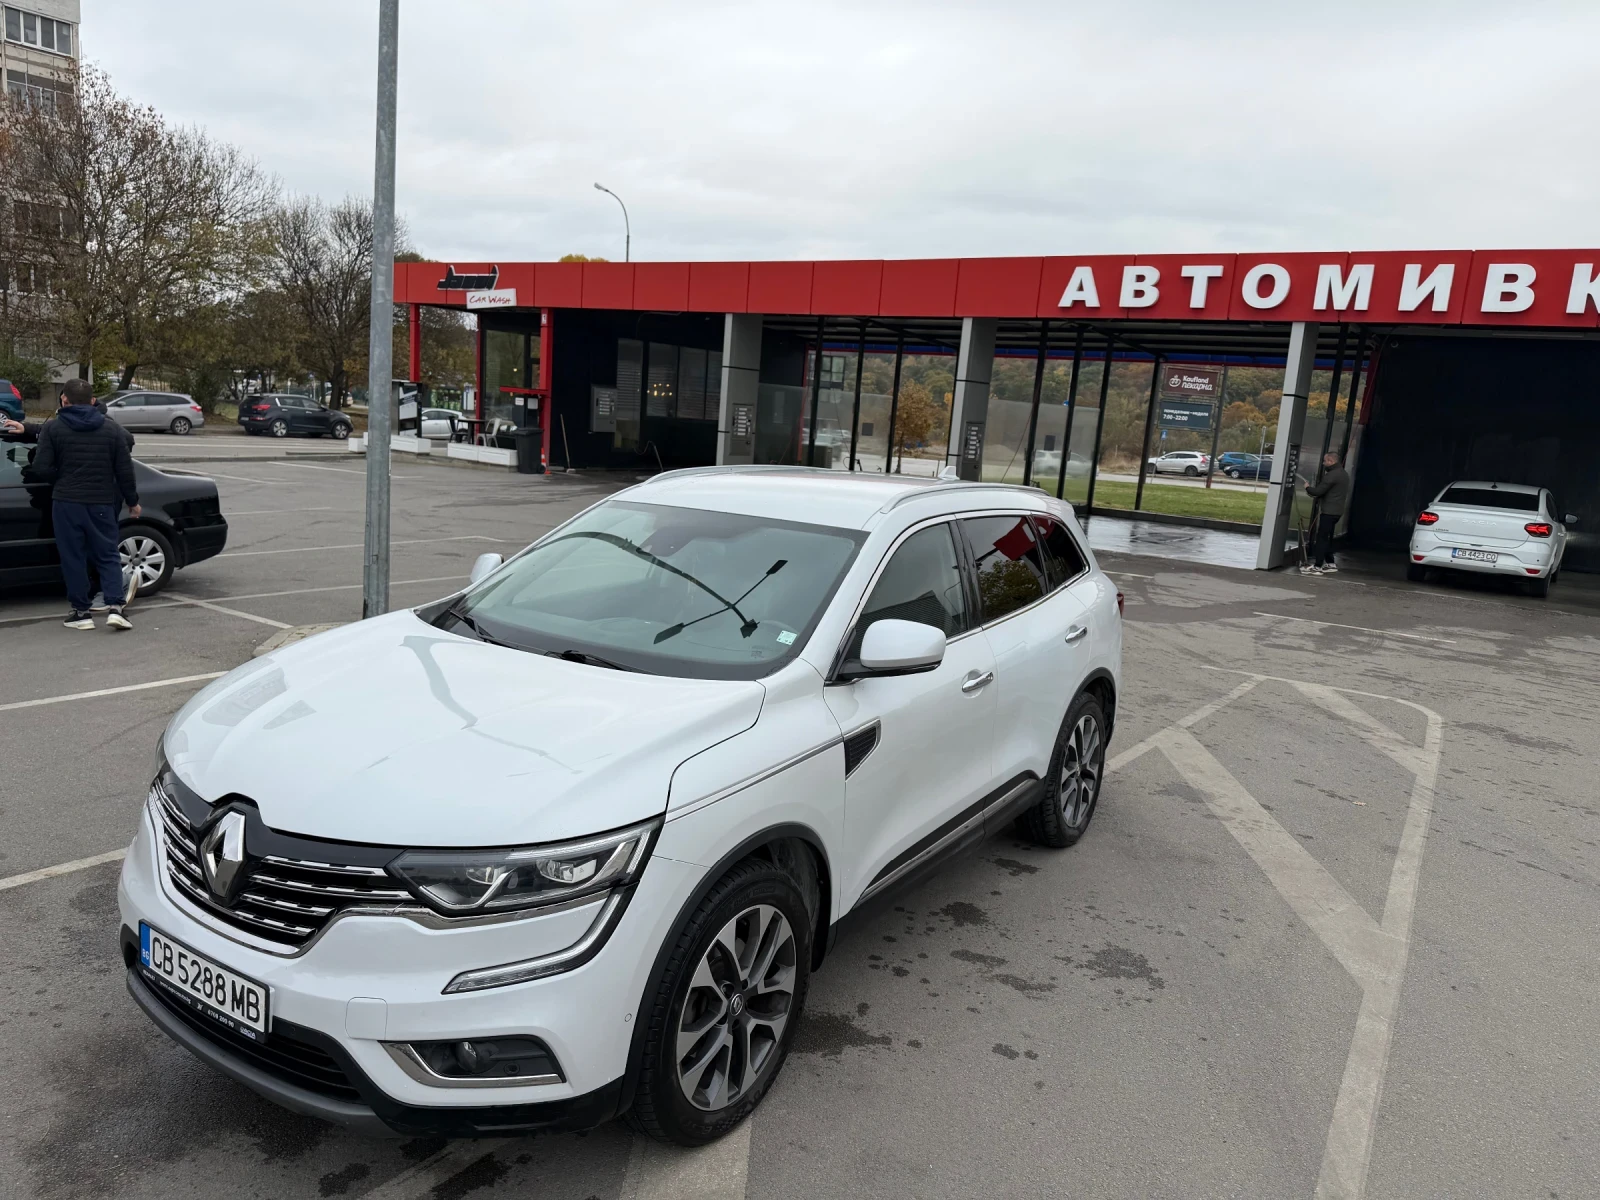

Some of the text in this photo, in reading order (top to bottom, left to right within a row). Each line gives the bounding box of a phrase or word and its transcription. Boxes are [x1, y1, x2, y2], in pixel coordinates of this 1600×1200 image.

[469, 295, 512, 305] CAR WASH
[1182, 375, 1209, 384] Kaufland
[1467, 551, 1485, 559] 4423
[152, 936, 174, 976] CB
[178, 950, 227, 1006] 5288
[231, 979, 261, 1023] MB
